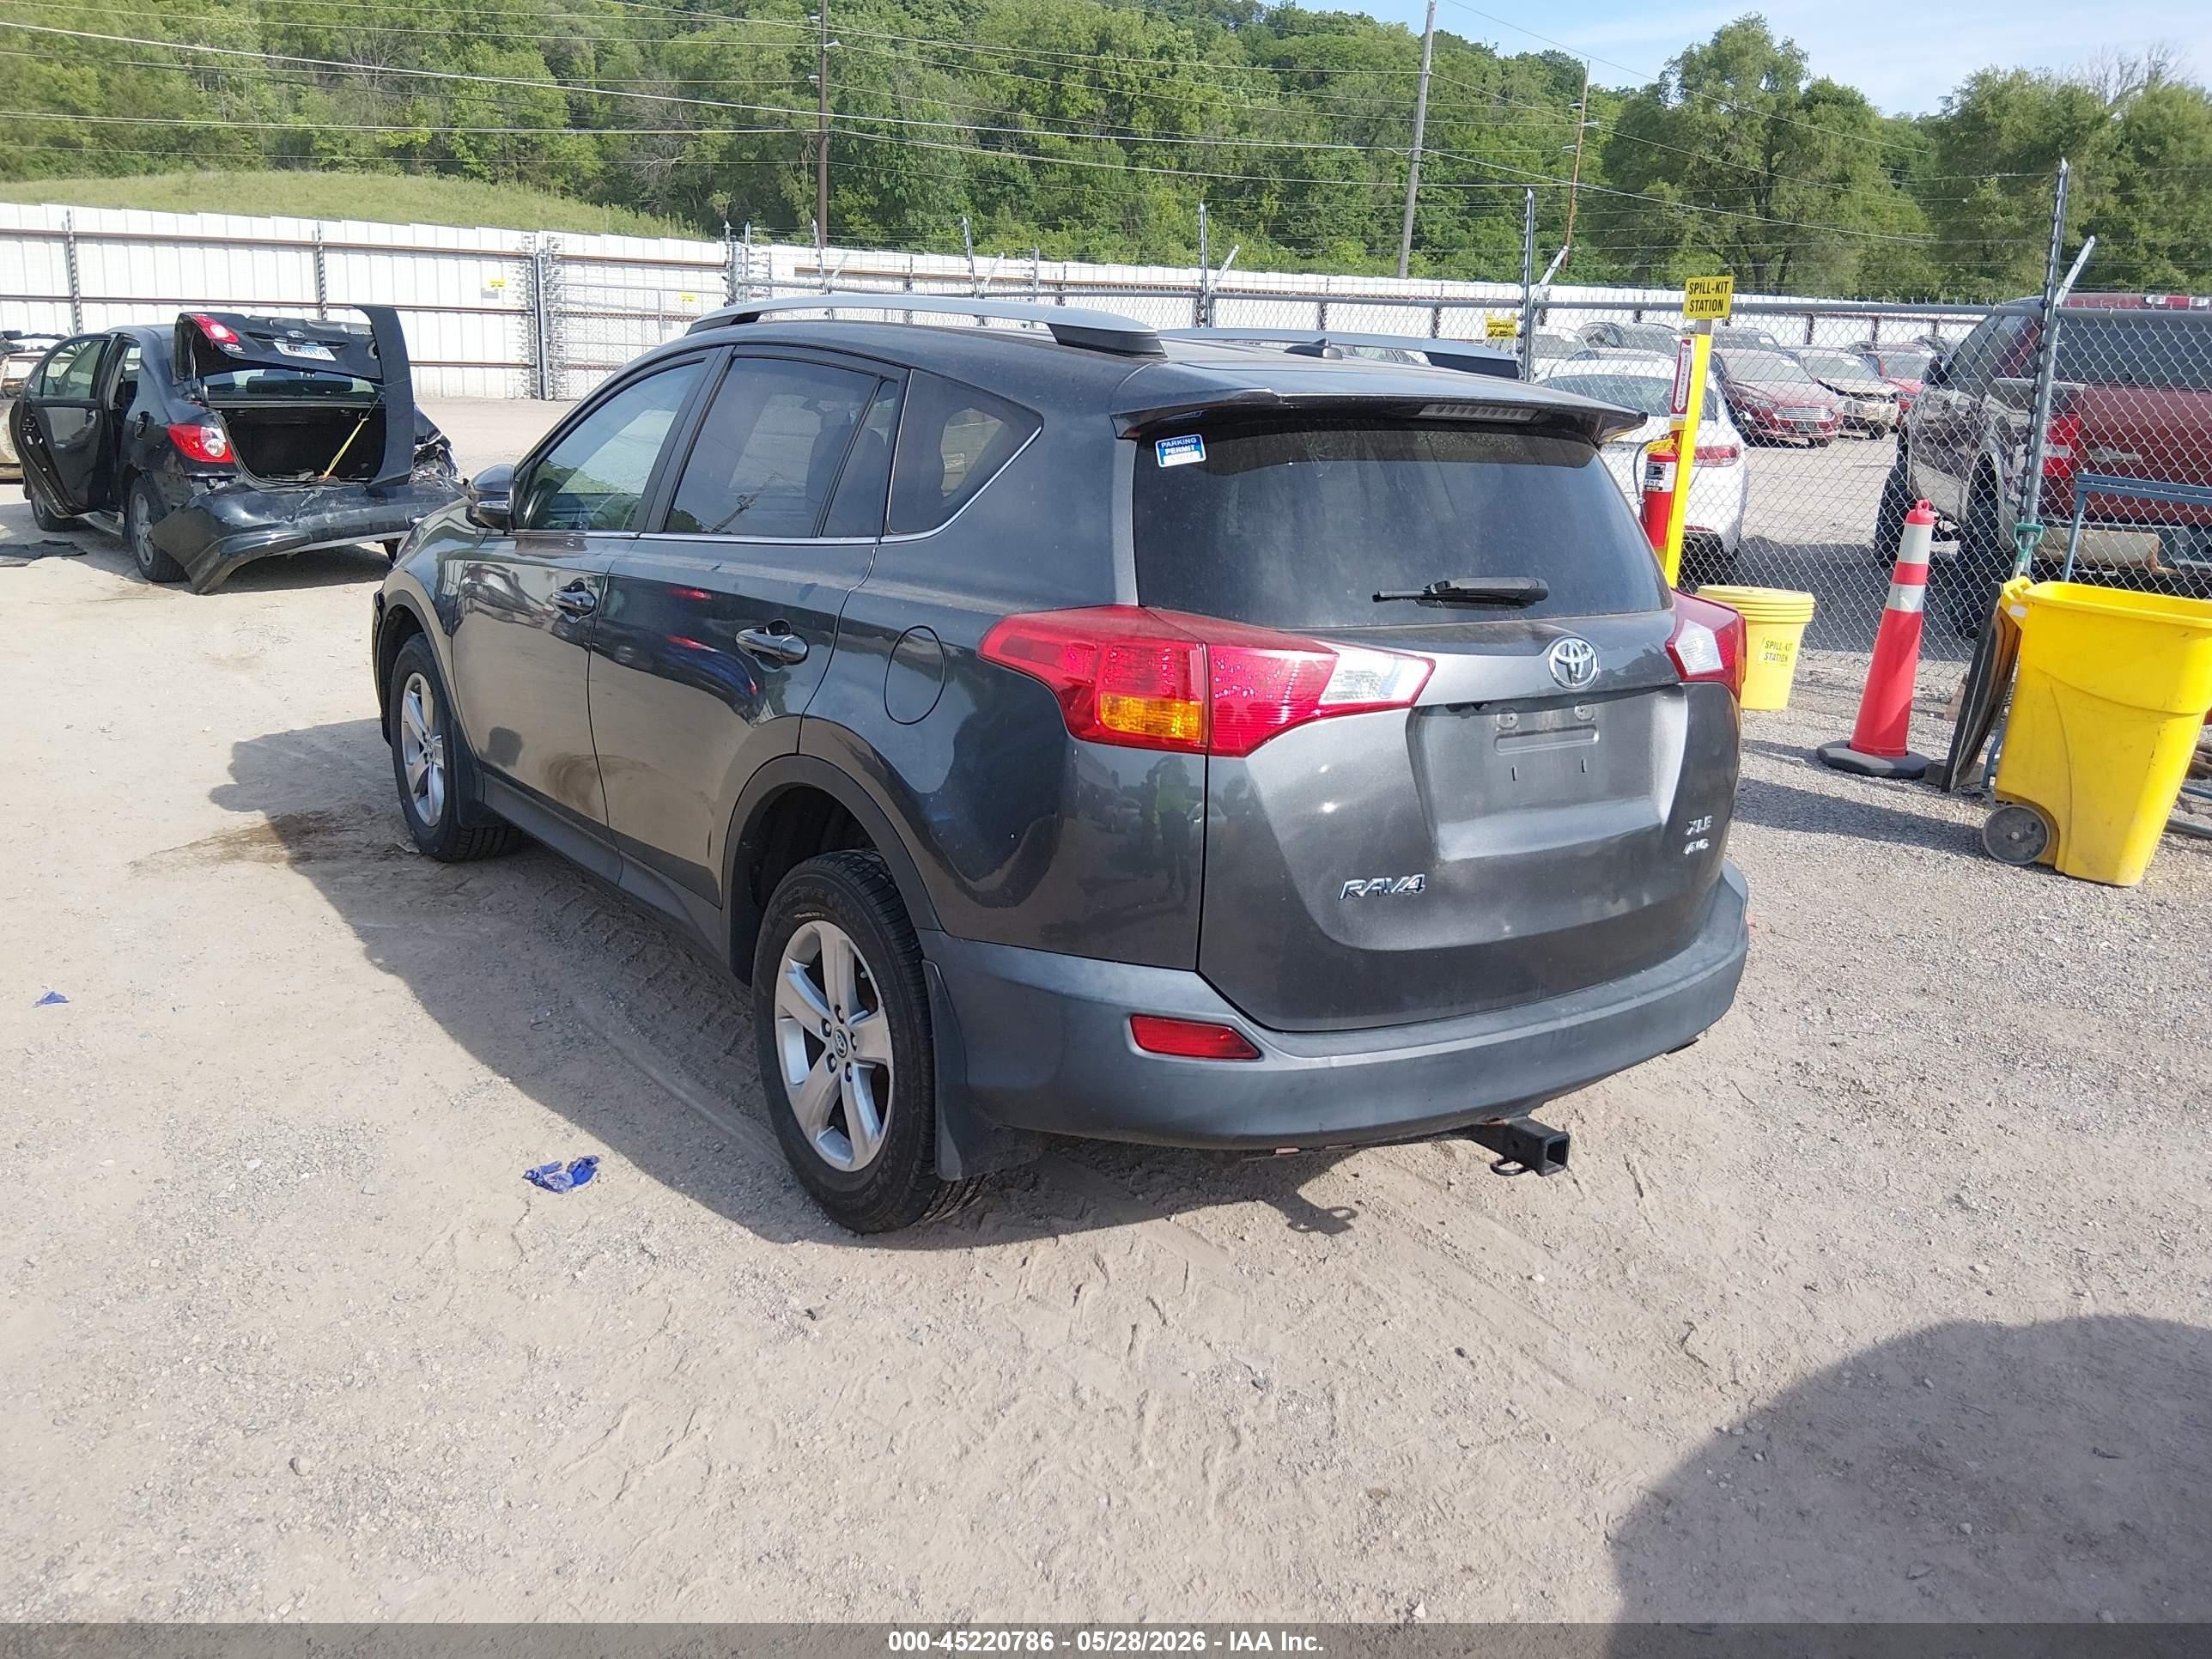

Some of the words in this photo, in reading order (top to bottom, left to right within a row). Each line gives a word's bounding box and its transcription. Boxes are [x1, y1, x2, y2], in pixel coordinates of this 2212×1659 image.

[1689, 281, 1729, 295] SPILL-KIT
[1689, 298, 1723, 313] STATION
[1161, 437, 1197, 448] PARKING
[1164, 444, 1195, 455] PERMIT
[1764, 652, 1788, 663] STATION
[1339, 874, 1425, 900] RAV4
